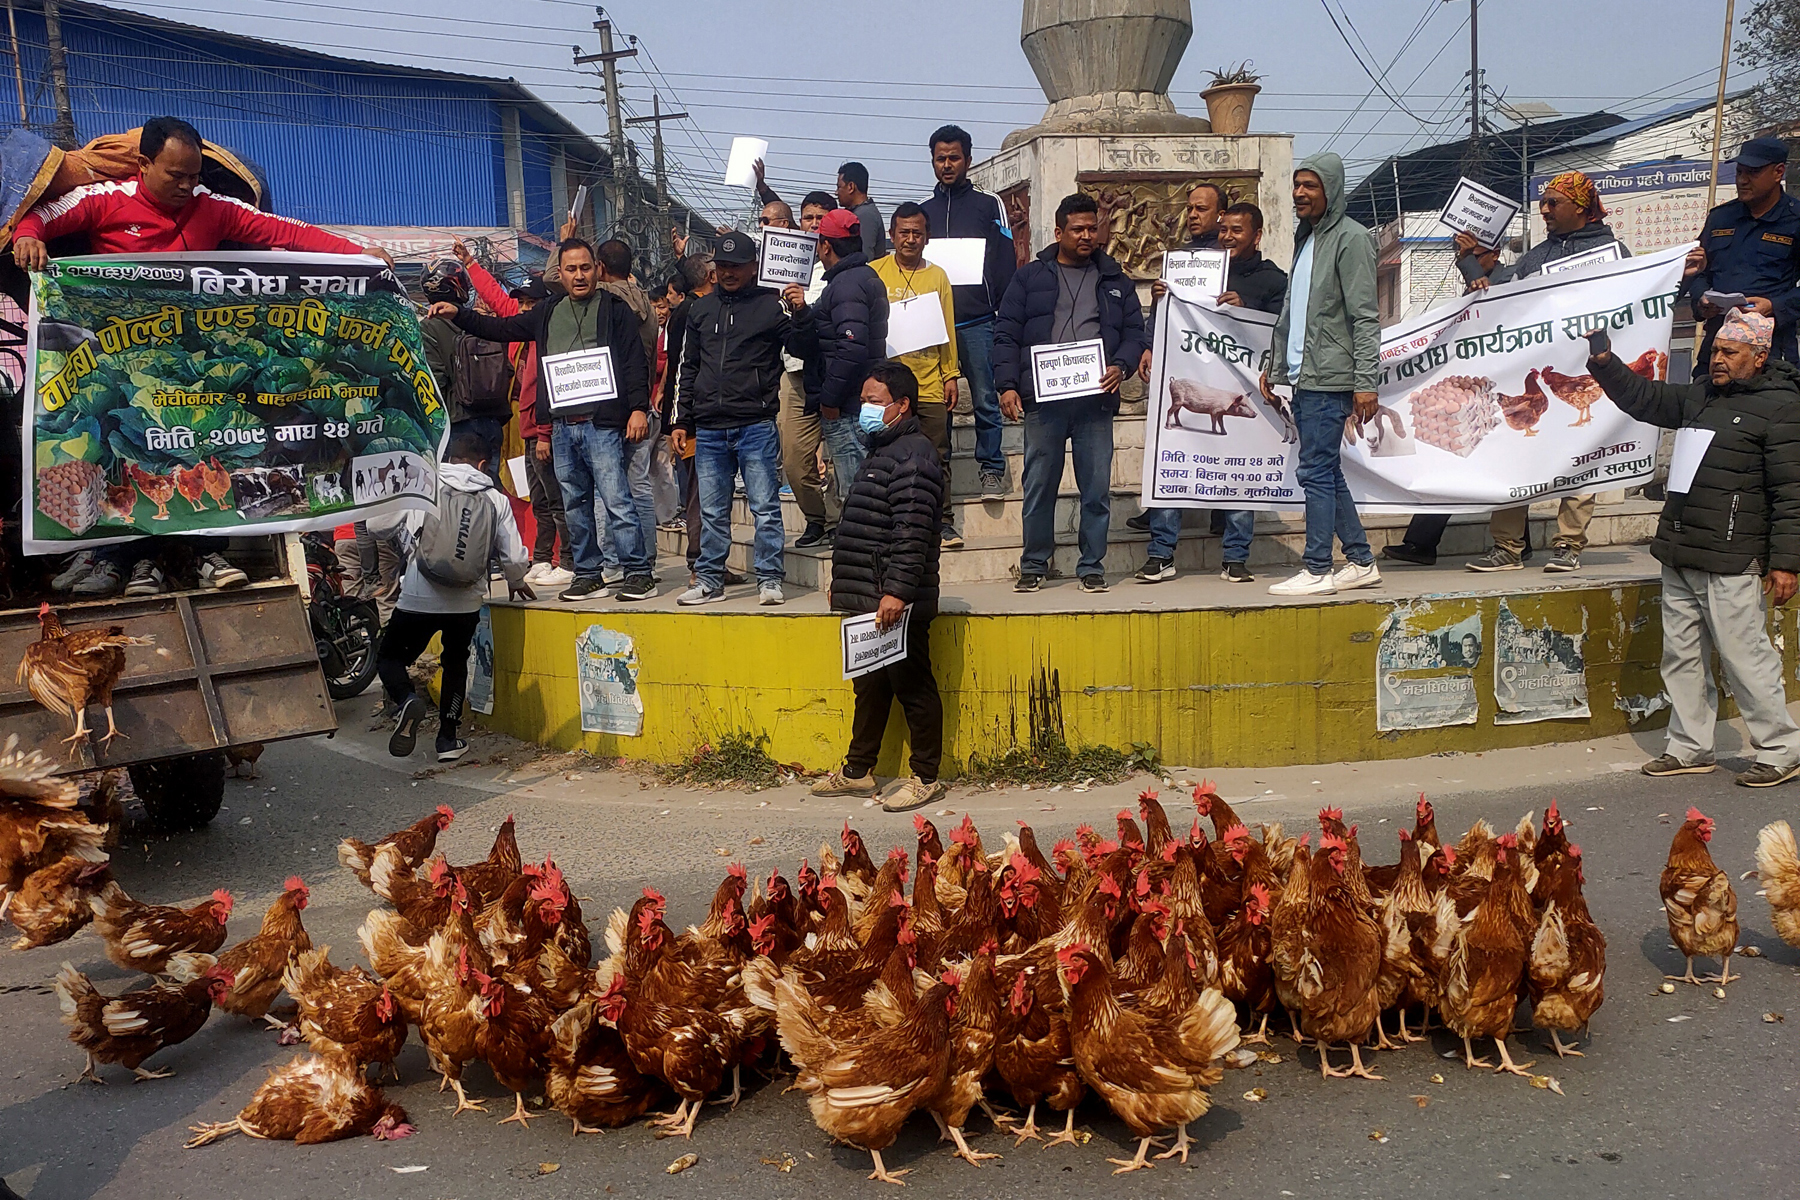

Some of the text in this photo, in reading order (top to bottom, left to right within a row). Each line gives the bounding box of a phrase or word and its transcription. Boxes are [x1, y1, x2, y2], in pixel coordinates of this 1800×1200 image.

[1107, 144, 1161, 167] मुक्ति
[1594, 175, 1633, 192] ट्राफिक
[1636, 171, 1664, 187] प्रहरी
[770, 236, 797, 250] चितवन
[1168, 258, 1186, 269] किसान
[190, 267, 369, 296] बिरोध सभा
[96, 305, 184, 354] पोल्ट्री
[195, 304, 260, 332] एण्ड
[267, 298, 331, 338] कृषि
[337, 316, 391, 350] फर्म
[1455, 324, 1553, 359] कार्यक्रम
[1561, 303, 1634, 340] सफल
[1410, 335, 1429, 349] एक
[1039, 356, 1061, 370] सम्पूर्ण
[1046, 378, 1058, 388] एक
[1059, 376, 1072, 388] जुट
[340, 385, 379, 399] झापा
[210, 428, 267, 446] २०७९
[274, 424, 317, 442] माघ
[323, 422, 350, 438] २४
[357, 415, 386, 434] गते
[1193, 454, 1220, 465] २०७९
[1224, 457, 1247, 467] माघ
[1249, 458, 1263, 467] २४
[1267, 454, 1285, 466] गते
[1195, 467, 1227, 482] बिहान
[1265, 469, 1283, 482] बजे
[1510, 454, 1652, 498] झापा जिल्ला सम्पूर्ण
[1403, 680, 1473, 695] महाधिवेशन
[1518, 674, 1580, 689] महाधिवेशन
